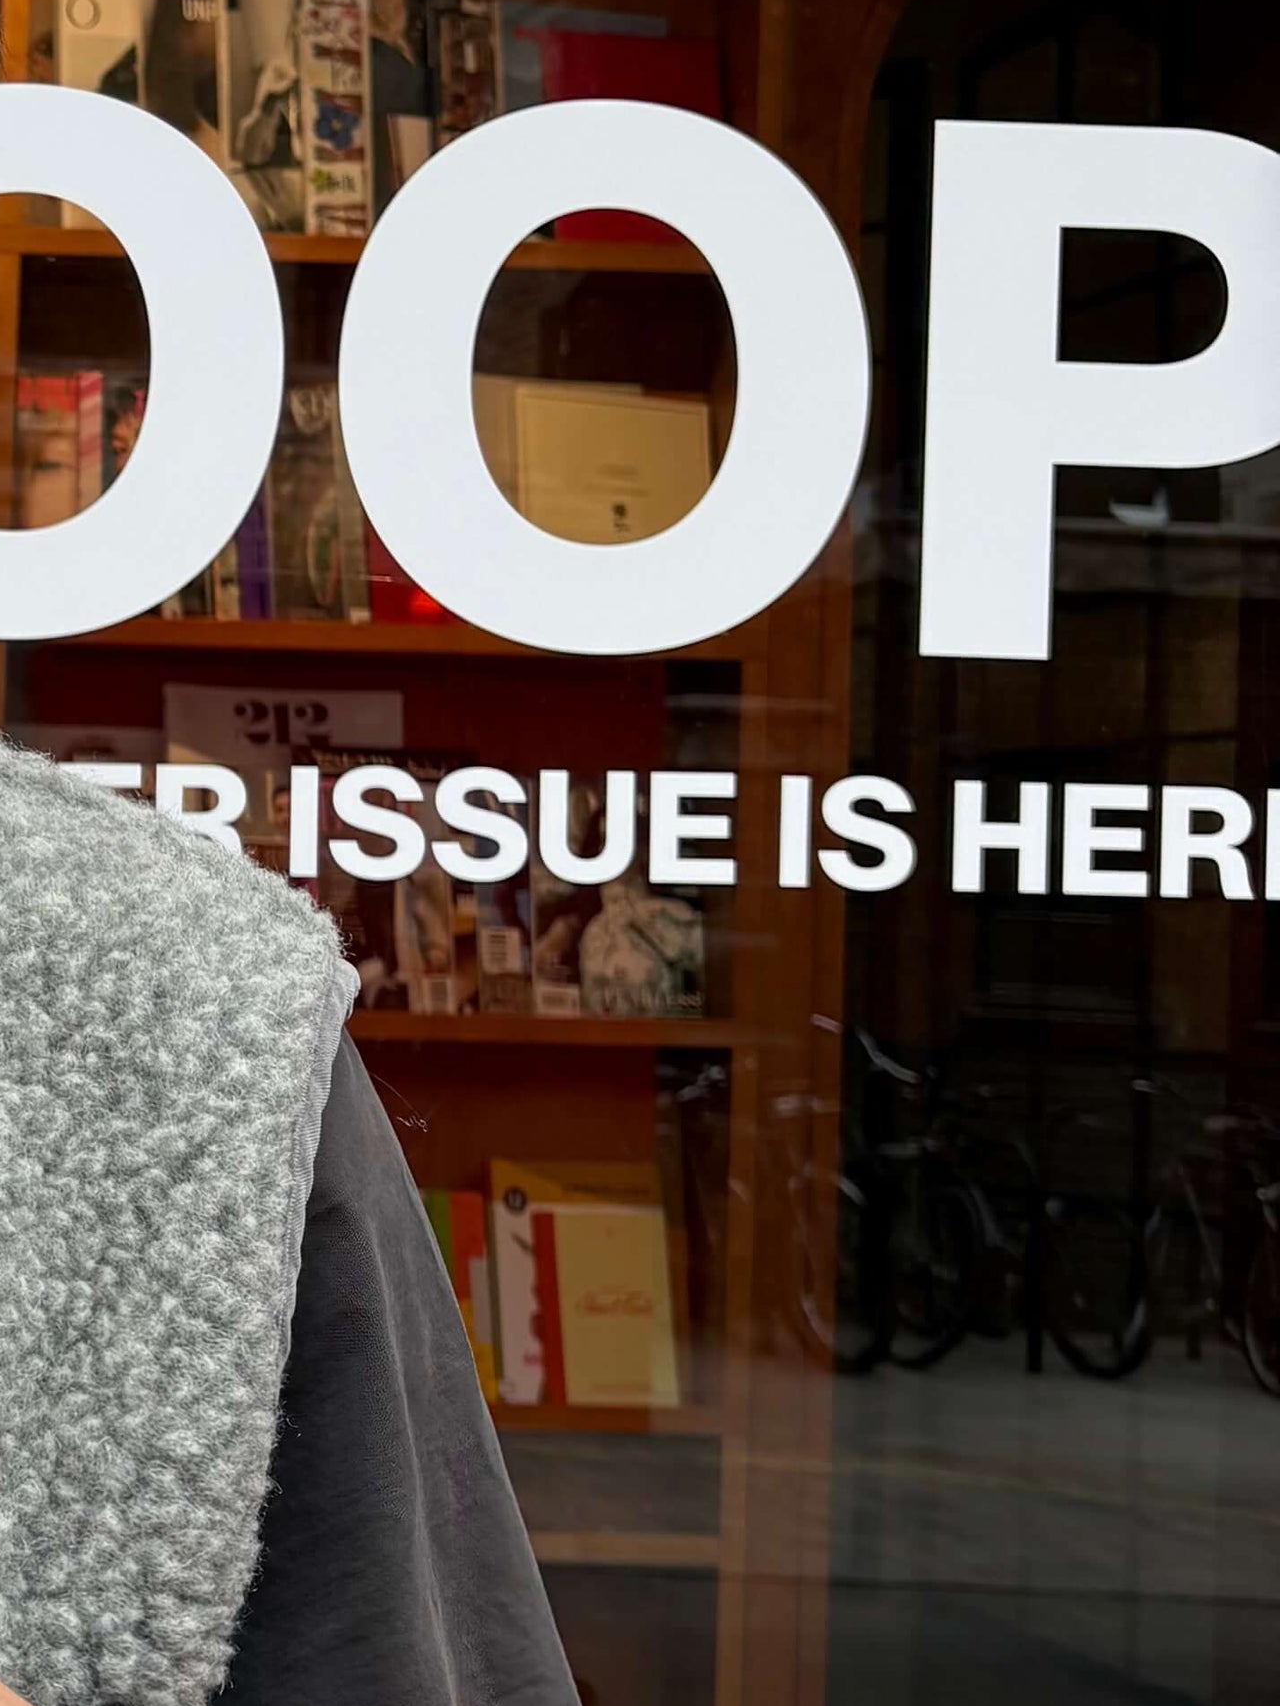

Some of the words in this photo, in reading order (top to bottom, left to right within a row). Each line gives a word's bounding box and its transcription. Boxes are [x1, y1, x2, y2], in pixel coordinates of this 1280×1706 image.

[289, 764, 738, 885] ISSUE
[778, 775, 917, 893] IS
[951, 779, 1280, 902] HER
